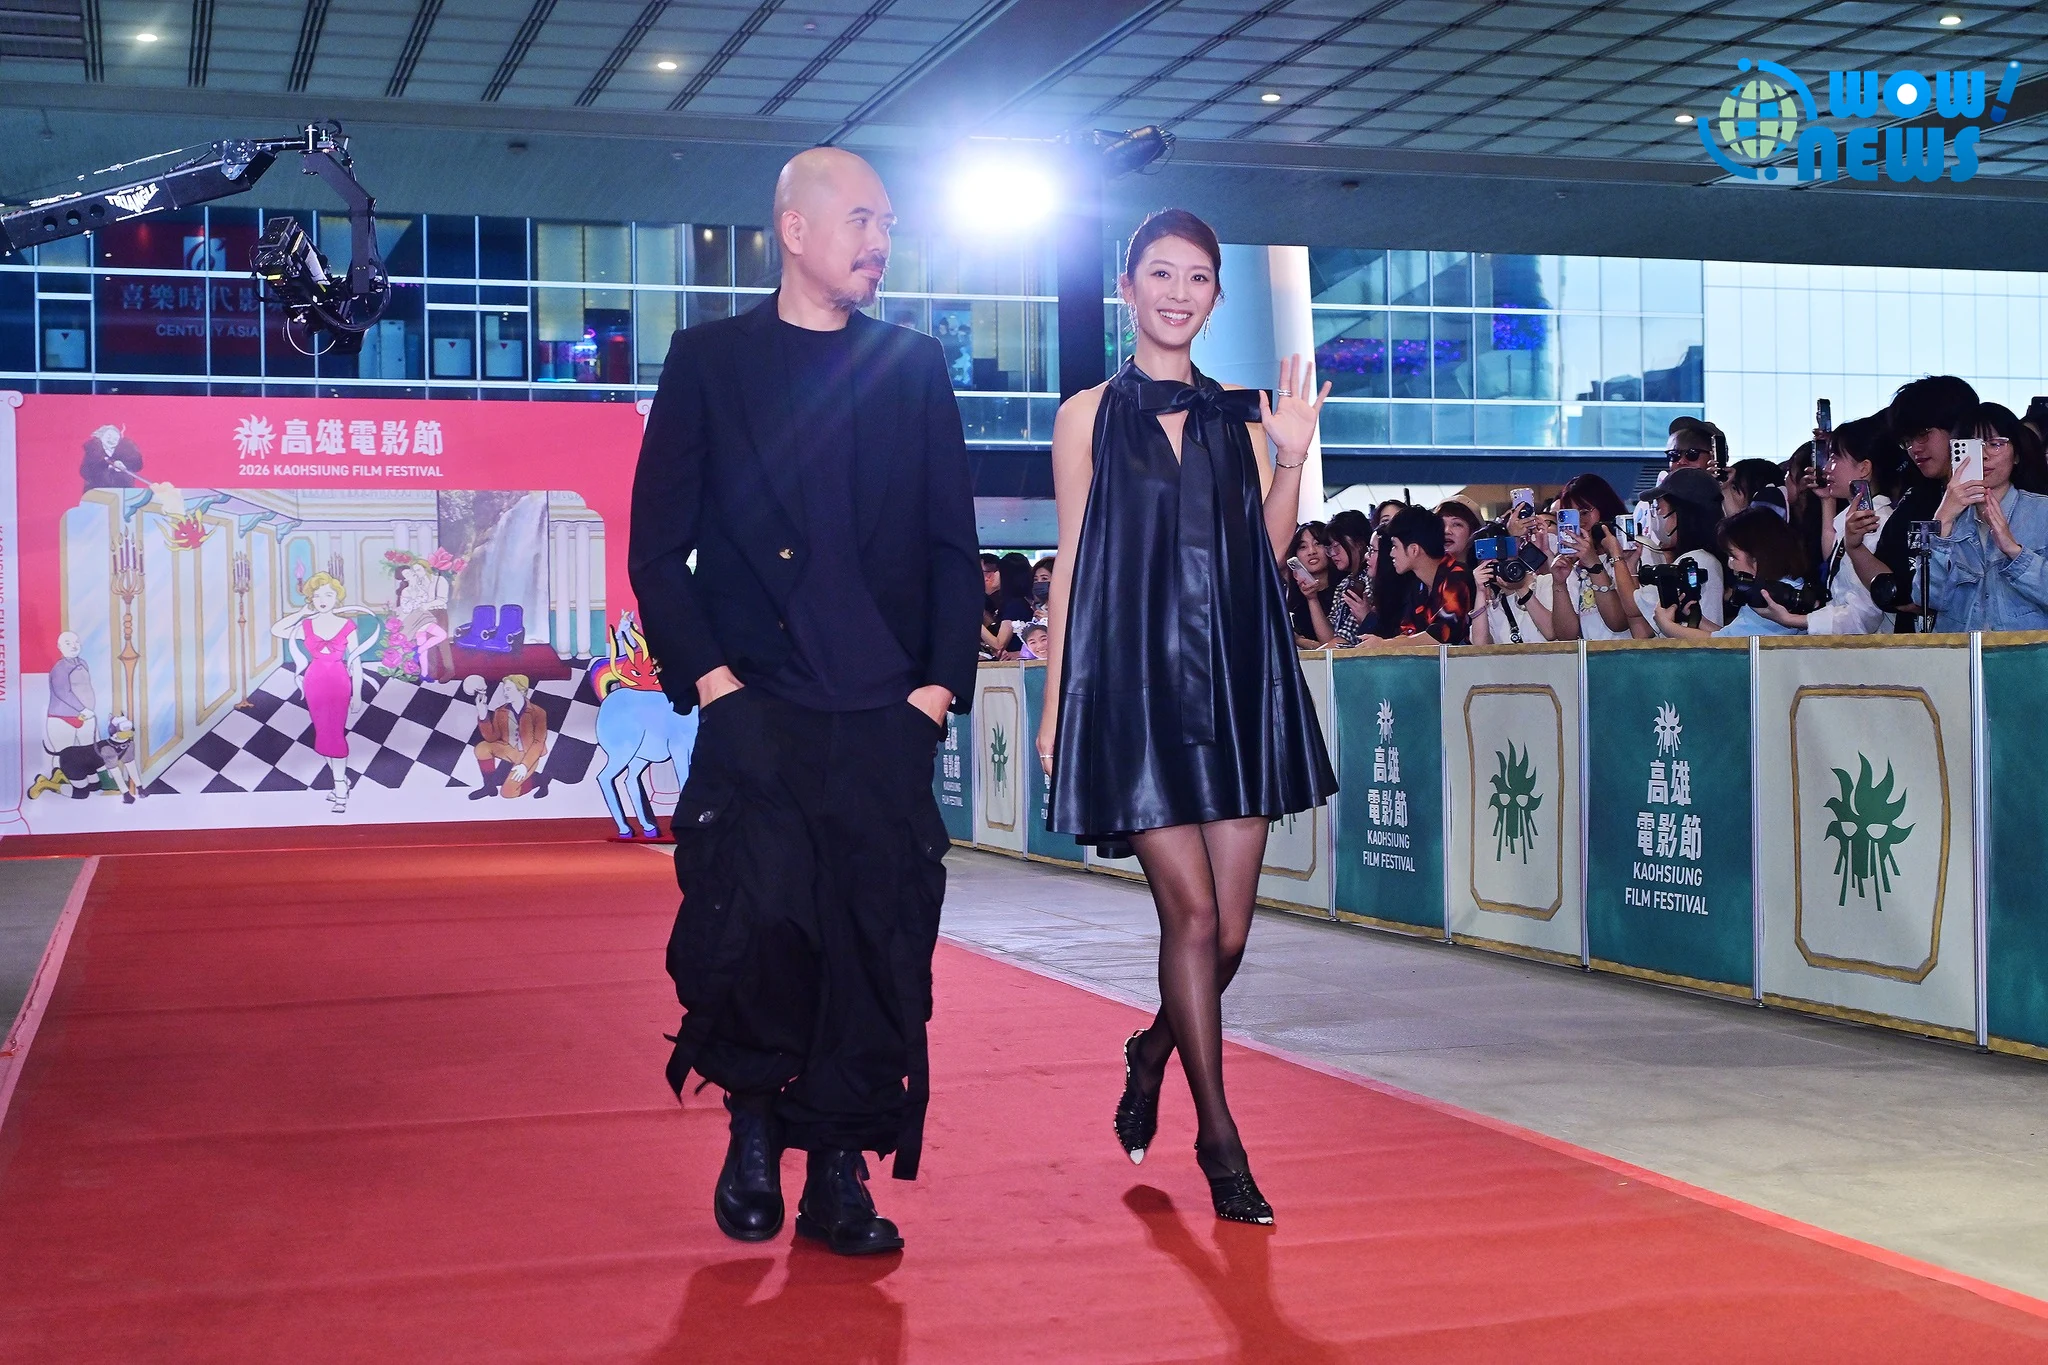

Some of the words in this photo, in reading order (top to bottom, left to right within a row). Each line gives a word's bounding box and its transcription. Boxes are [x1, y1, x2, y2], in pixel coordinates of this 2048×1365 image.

[226, 325, 260, 338] ASIA
[281, 418, 444, 456] 高雄電影節
[239, 464, 270, 476] 2026
[273, 464, 350, 477] KAOHSIUNG
[352, 465, 382, 477] FILM
[385, 465, 444, 477] FESTIVAL
[1373, 746, 1401, 784] 高雄
[1646, 759, 1692, 806] 高雄
[1367, 789, 1409, 828] 電影節
[1367, 829, 1410, 849] KAOHSIUNG
[1636, 811, 1702, 861] 電影節
[1362, 850, 1380, 868] FILM
[1381, 853, 1416, 873] FESTIVAL
[1633, 861, 1703, 887] KAOHSIUNG
[1625, 887, 1651, 908] FILM
[1653, 890, 1709, 916] FESTIVAL
